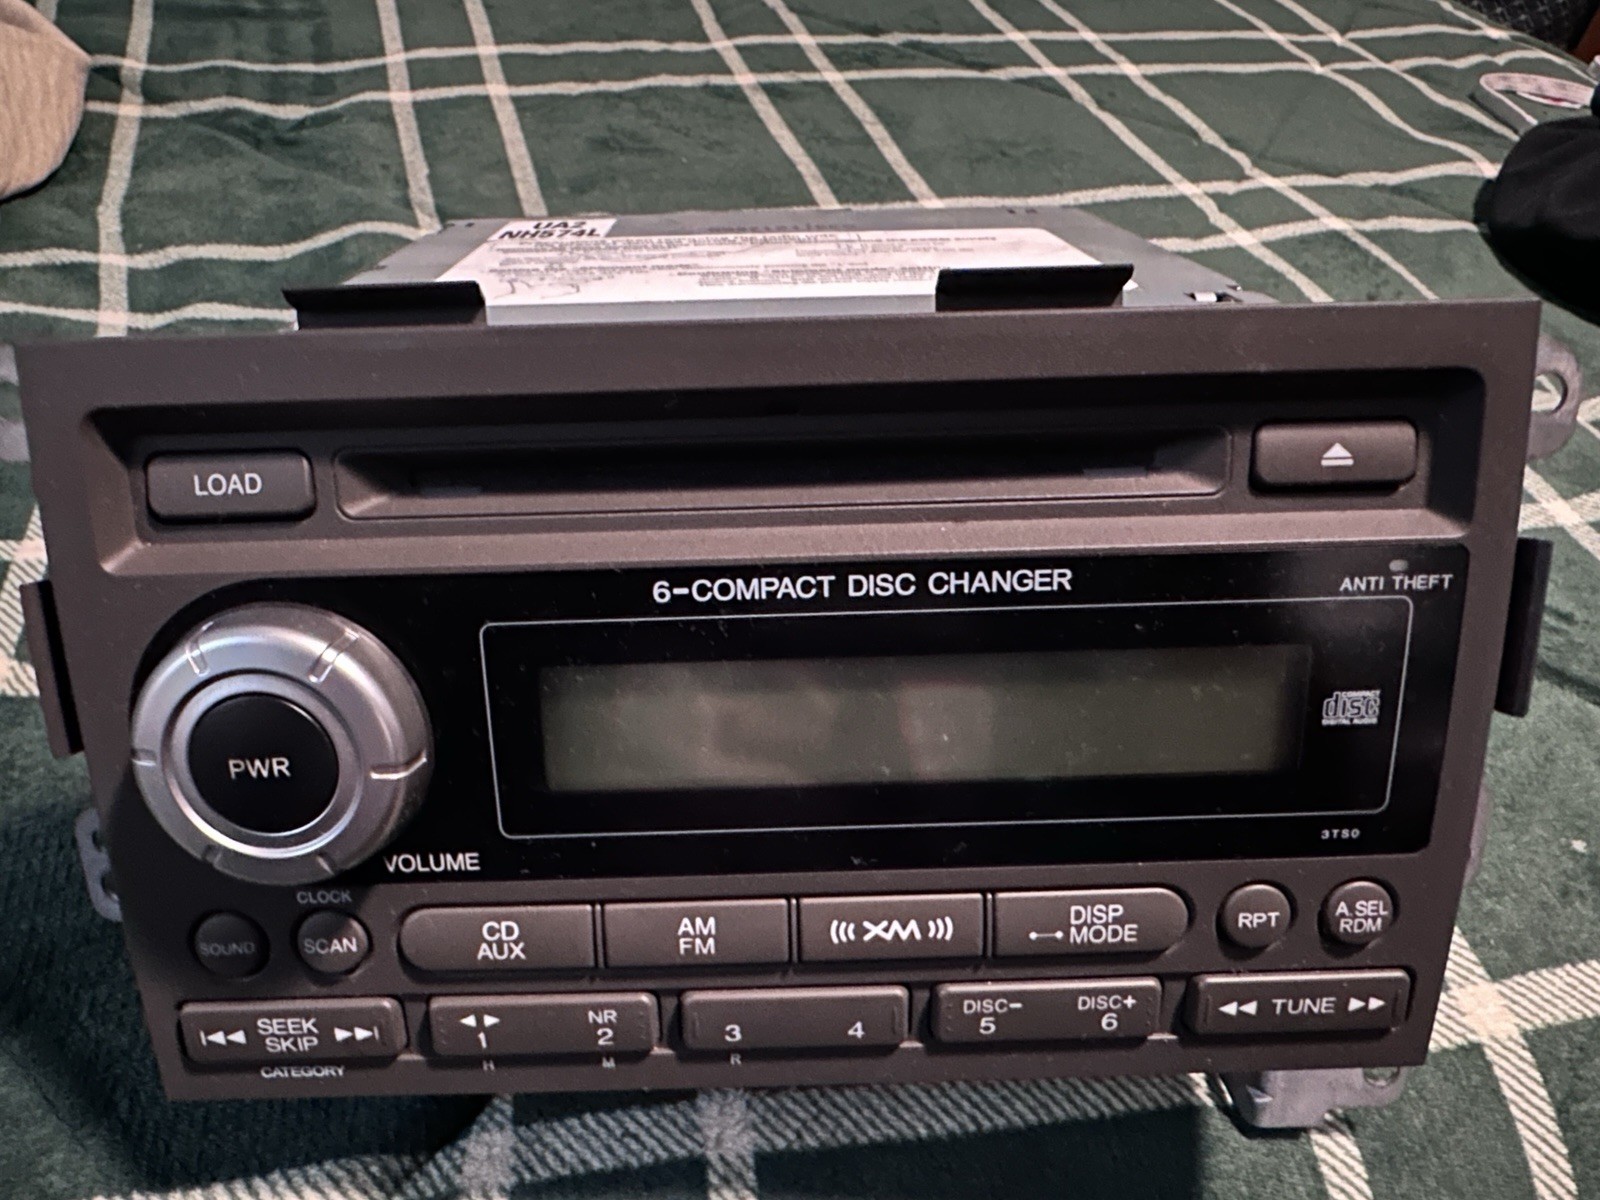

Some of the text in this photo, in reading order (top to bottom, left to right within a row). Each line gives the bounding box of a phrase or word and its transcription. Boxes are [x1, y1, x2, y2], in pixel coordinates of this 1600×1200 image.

[500, 229, 600, 239] NH574L
[194, 473, 262, 496] LOAD
[652, 569, 1072, 603] 6-COMPACT DISC CHANGER
[1340, 574, 1453, 592] ANTI THEFT
[228, 757, 291, 779] PWR
[384, 852, 480, 872] VOLUME
[296, 889, 352, 904] CLOCK
[1070, 904, 1124, 926] DISP
[1238, 912, 1280, 929] RPT
[482, 921, 519, 941] CD
[678, 917, 716, 935] AM
[1069, 924, 1138, 944] MODE
[1339, 916, 1382, 934] RDM
[201, 940, 256, 956] SOUND
[303, 937, 357, 954] SCAN
[477, 941, 526, 961] AUX
[679, 937, 715, 955] FM
[963, 998, 1023, 1014] DISC-
[1077, 995, 1136, 1011] DISC+
[1271, 997, 1336, 1015] TUNE
[257, 1017, 319, 1036] SEEK
[588, 1010, 617, 1025] NR
[979, 1017, 996, 1035] 5
[1101, 1012, 1118, 1031] 6
[597, 1028, 614, 1045] 2
[724, 1024, 742, 1042] 3
[847, 1021, 865, 1039] 4
[265, 1034, 319, 1052] SKIP
[477, 1032, 487, 1049] 1
[483, 1060, 494, 1071] H
[731, 1053, 741, 1065] R
[260, 1064, 345, 1079] CATEGORY
